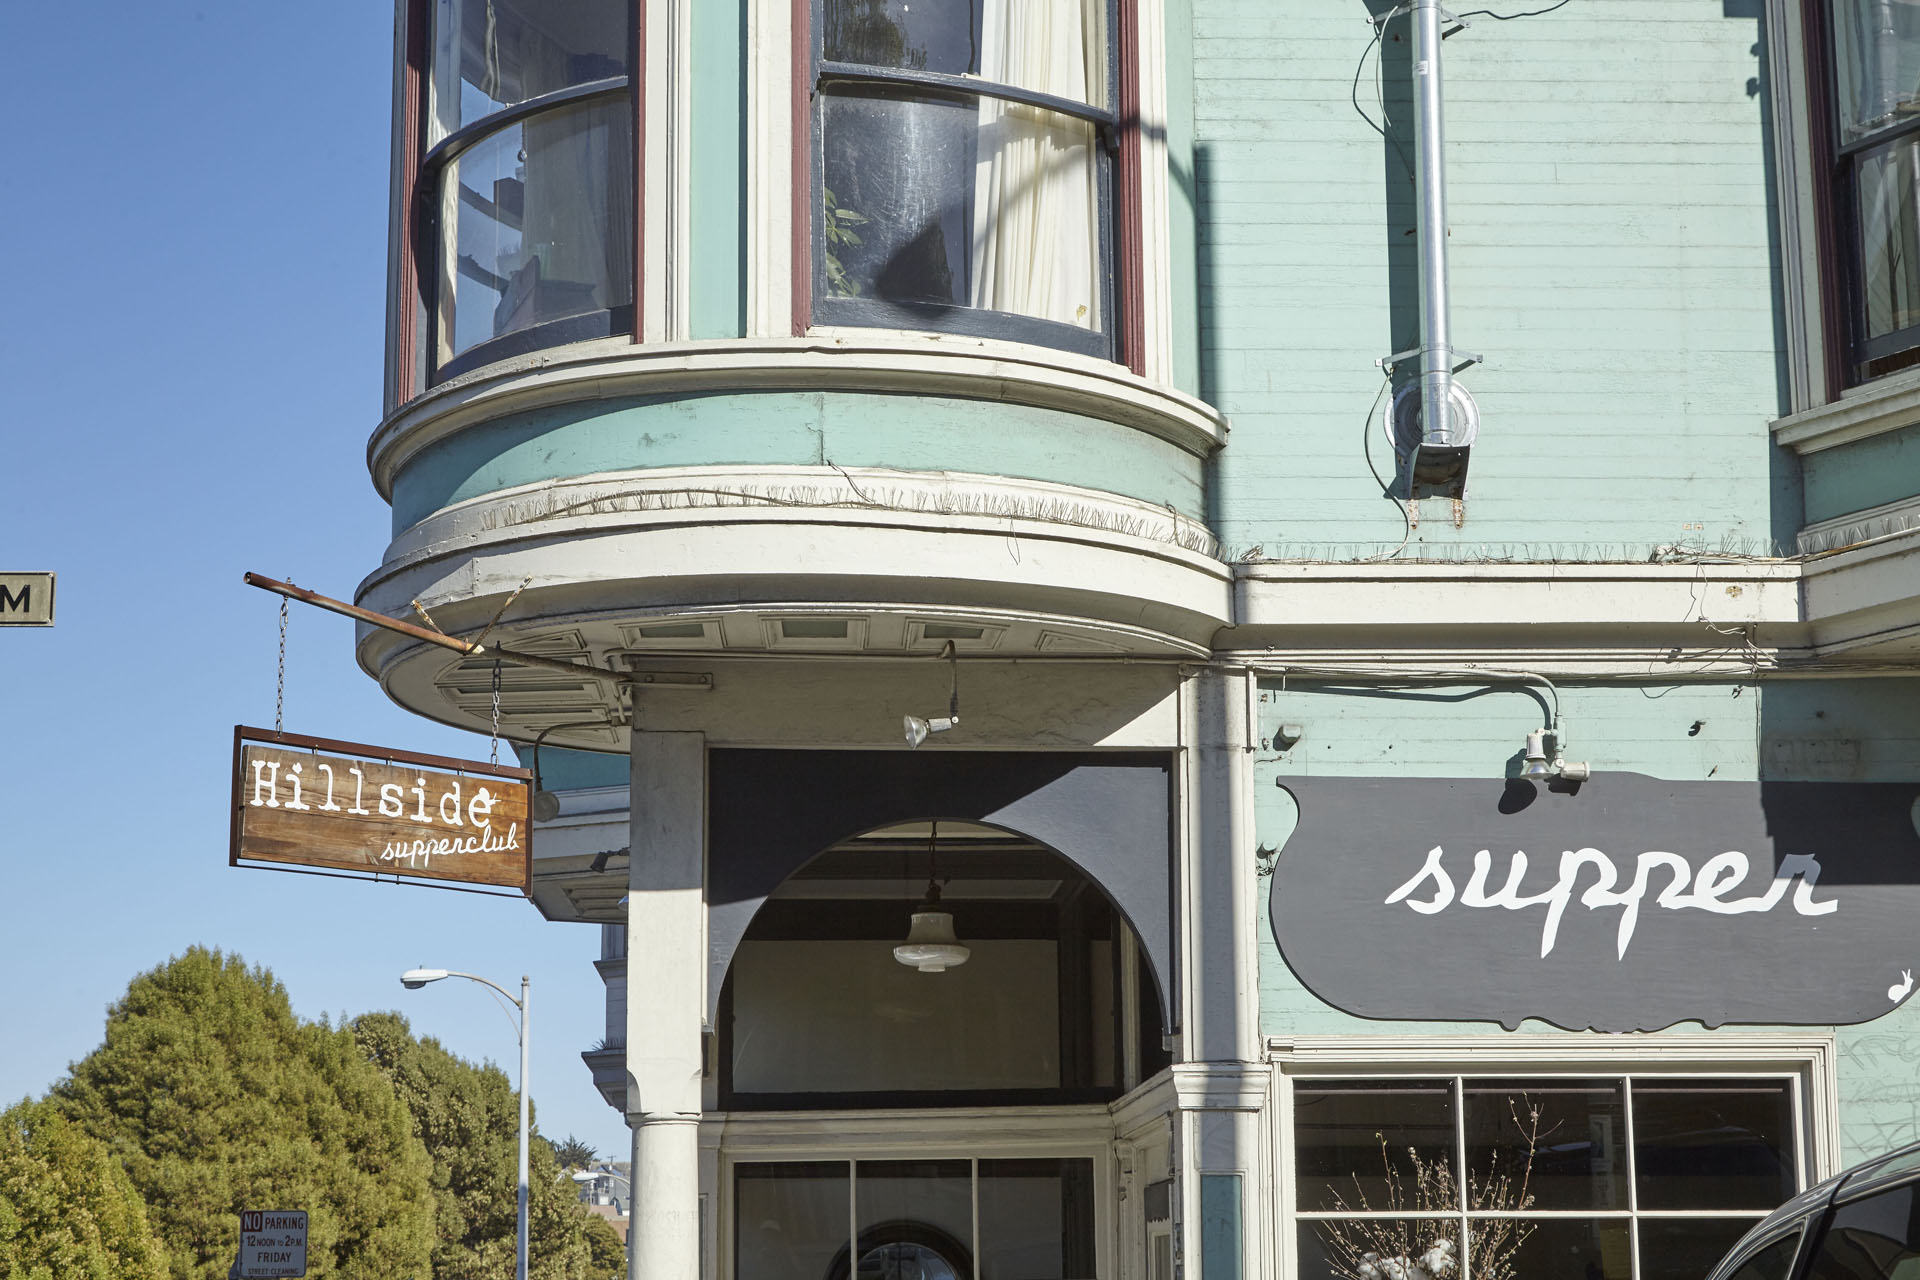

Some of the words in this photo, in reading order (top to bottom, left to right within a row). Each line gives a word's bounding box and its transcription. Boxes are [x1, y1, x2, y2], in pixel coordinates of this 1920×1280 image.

[0, 584, 31, 613] M
[249, 759, 493, 828] Hillside
[379, 822, 520, 868] supperclub
[1384, 845, 1838, 961] supper
[244, 1212, 261, 1230] NO
[265, 1216, 304, 1230] PARKING
[257, 1252, 292, 1263] FRIDAY
